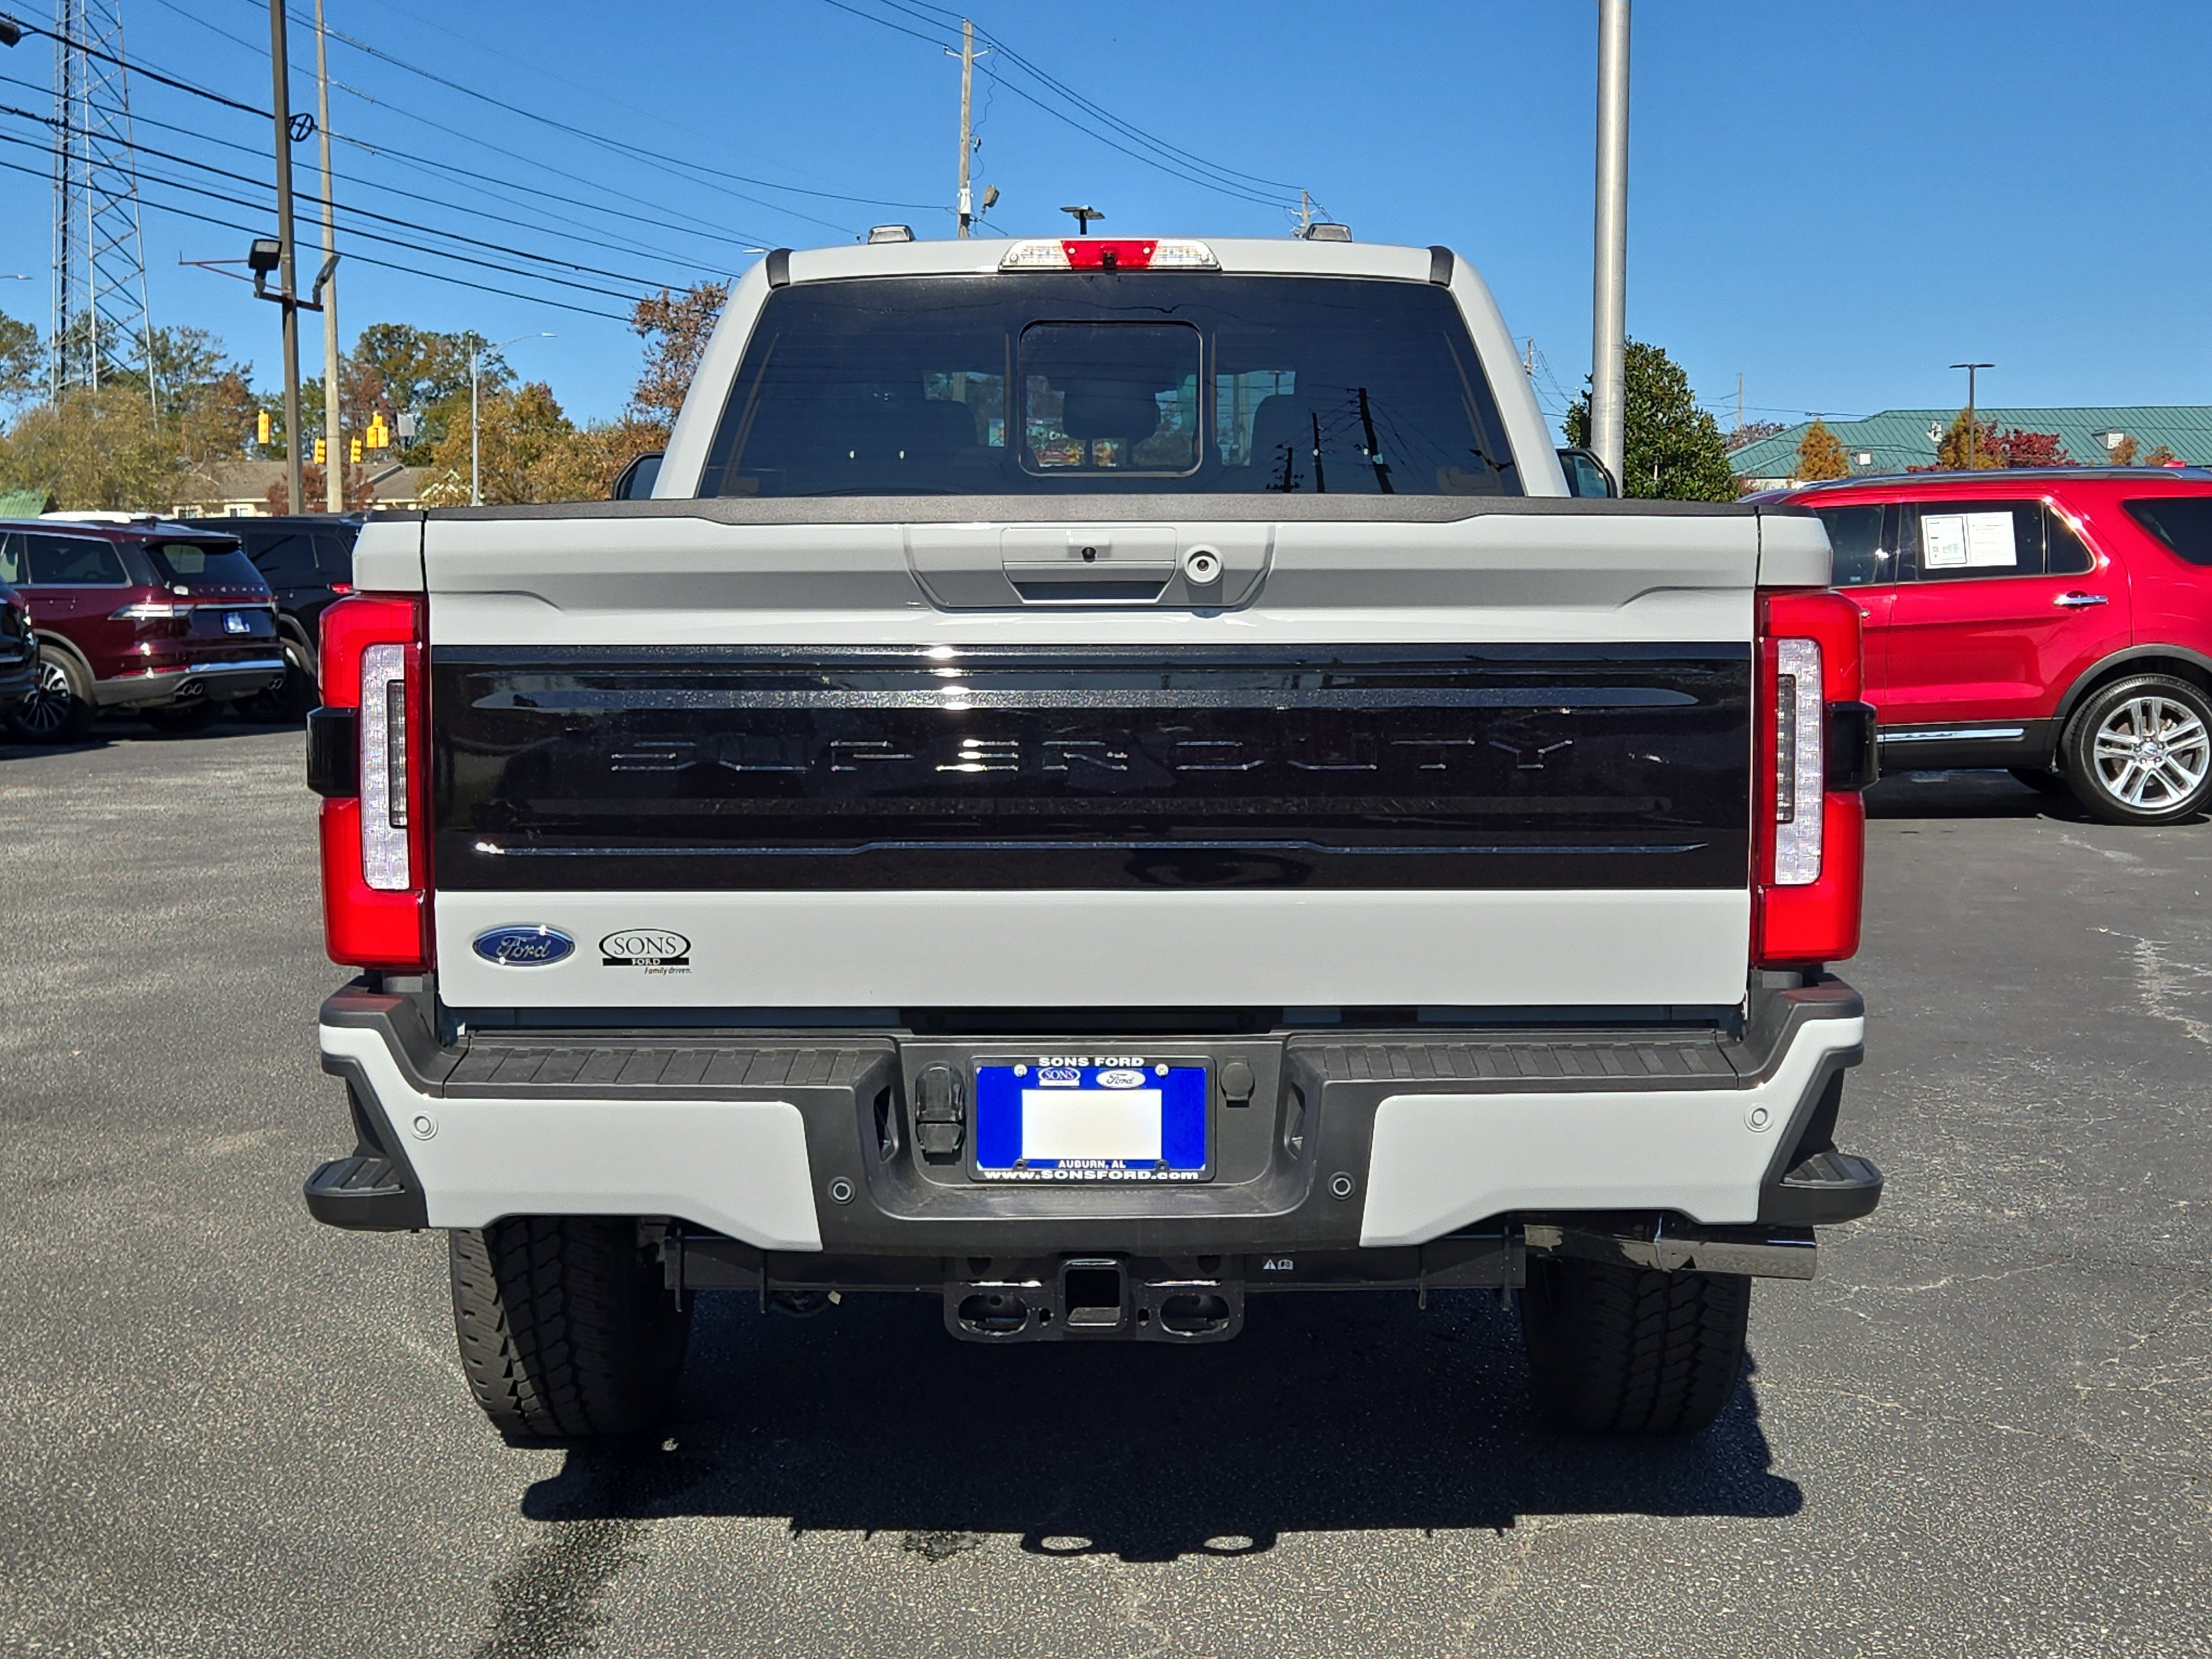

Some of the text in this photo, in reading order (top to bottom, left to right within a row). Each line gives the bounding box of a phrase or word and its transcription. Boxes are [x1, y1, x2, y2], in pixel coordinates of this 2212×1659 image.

[610, 734, 1573, 772] SUPER DUTY
[496, 935, 552, 957] Ford
[614, 936, 677, 955] SONS
[645, 967, 667, 976] Family
[1038, 1057, 1145, 1067] SONS FORD
[1044, 1069, 1075, 1080] SONS
[1106, 1072, 1135, 1085] Ford
[1058, 1160, 1127, 1169] AUBURN, AL
[983, 1170, 1199, 1180] www.SONSFORD.com
